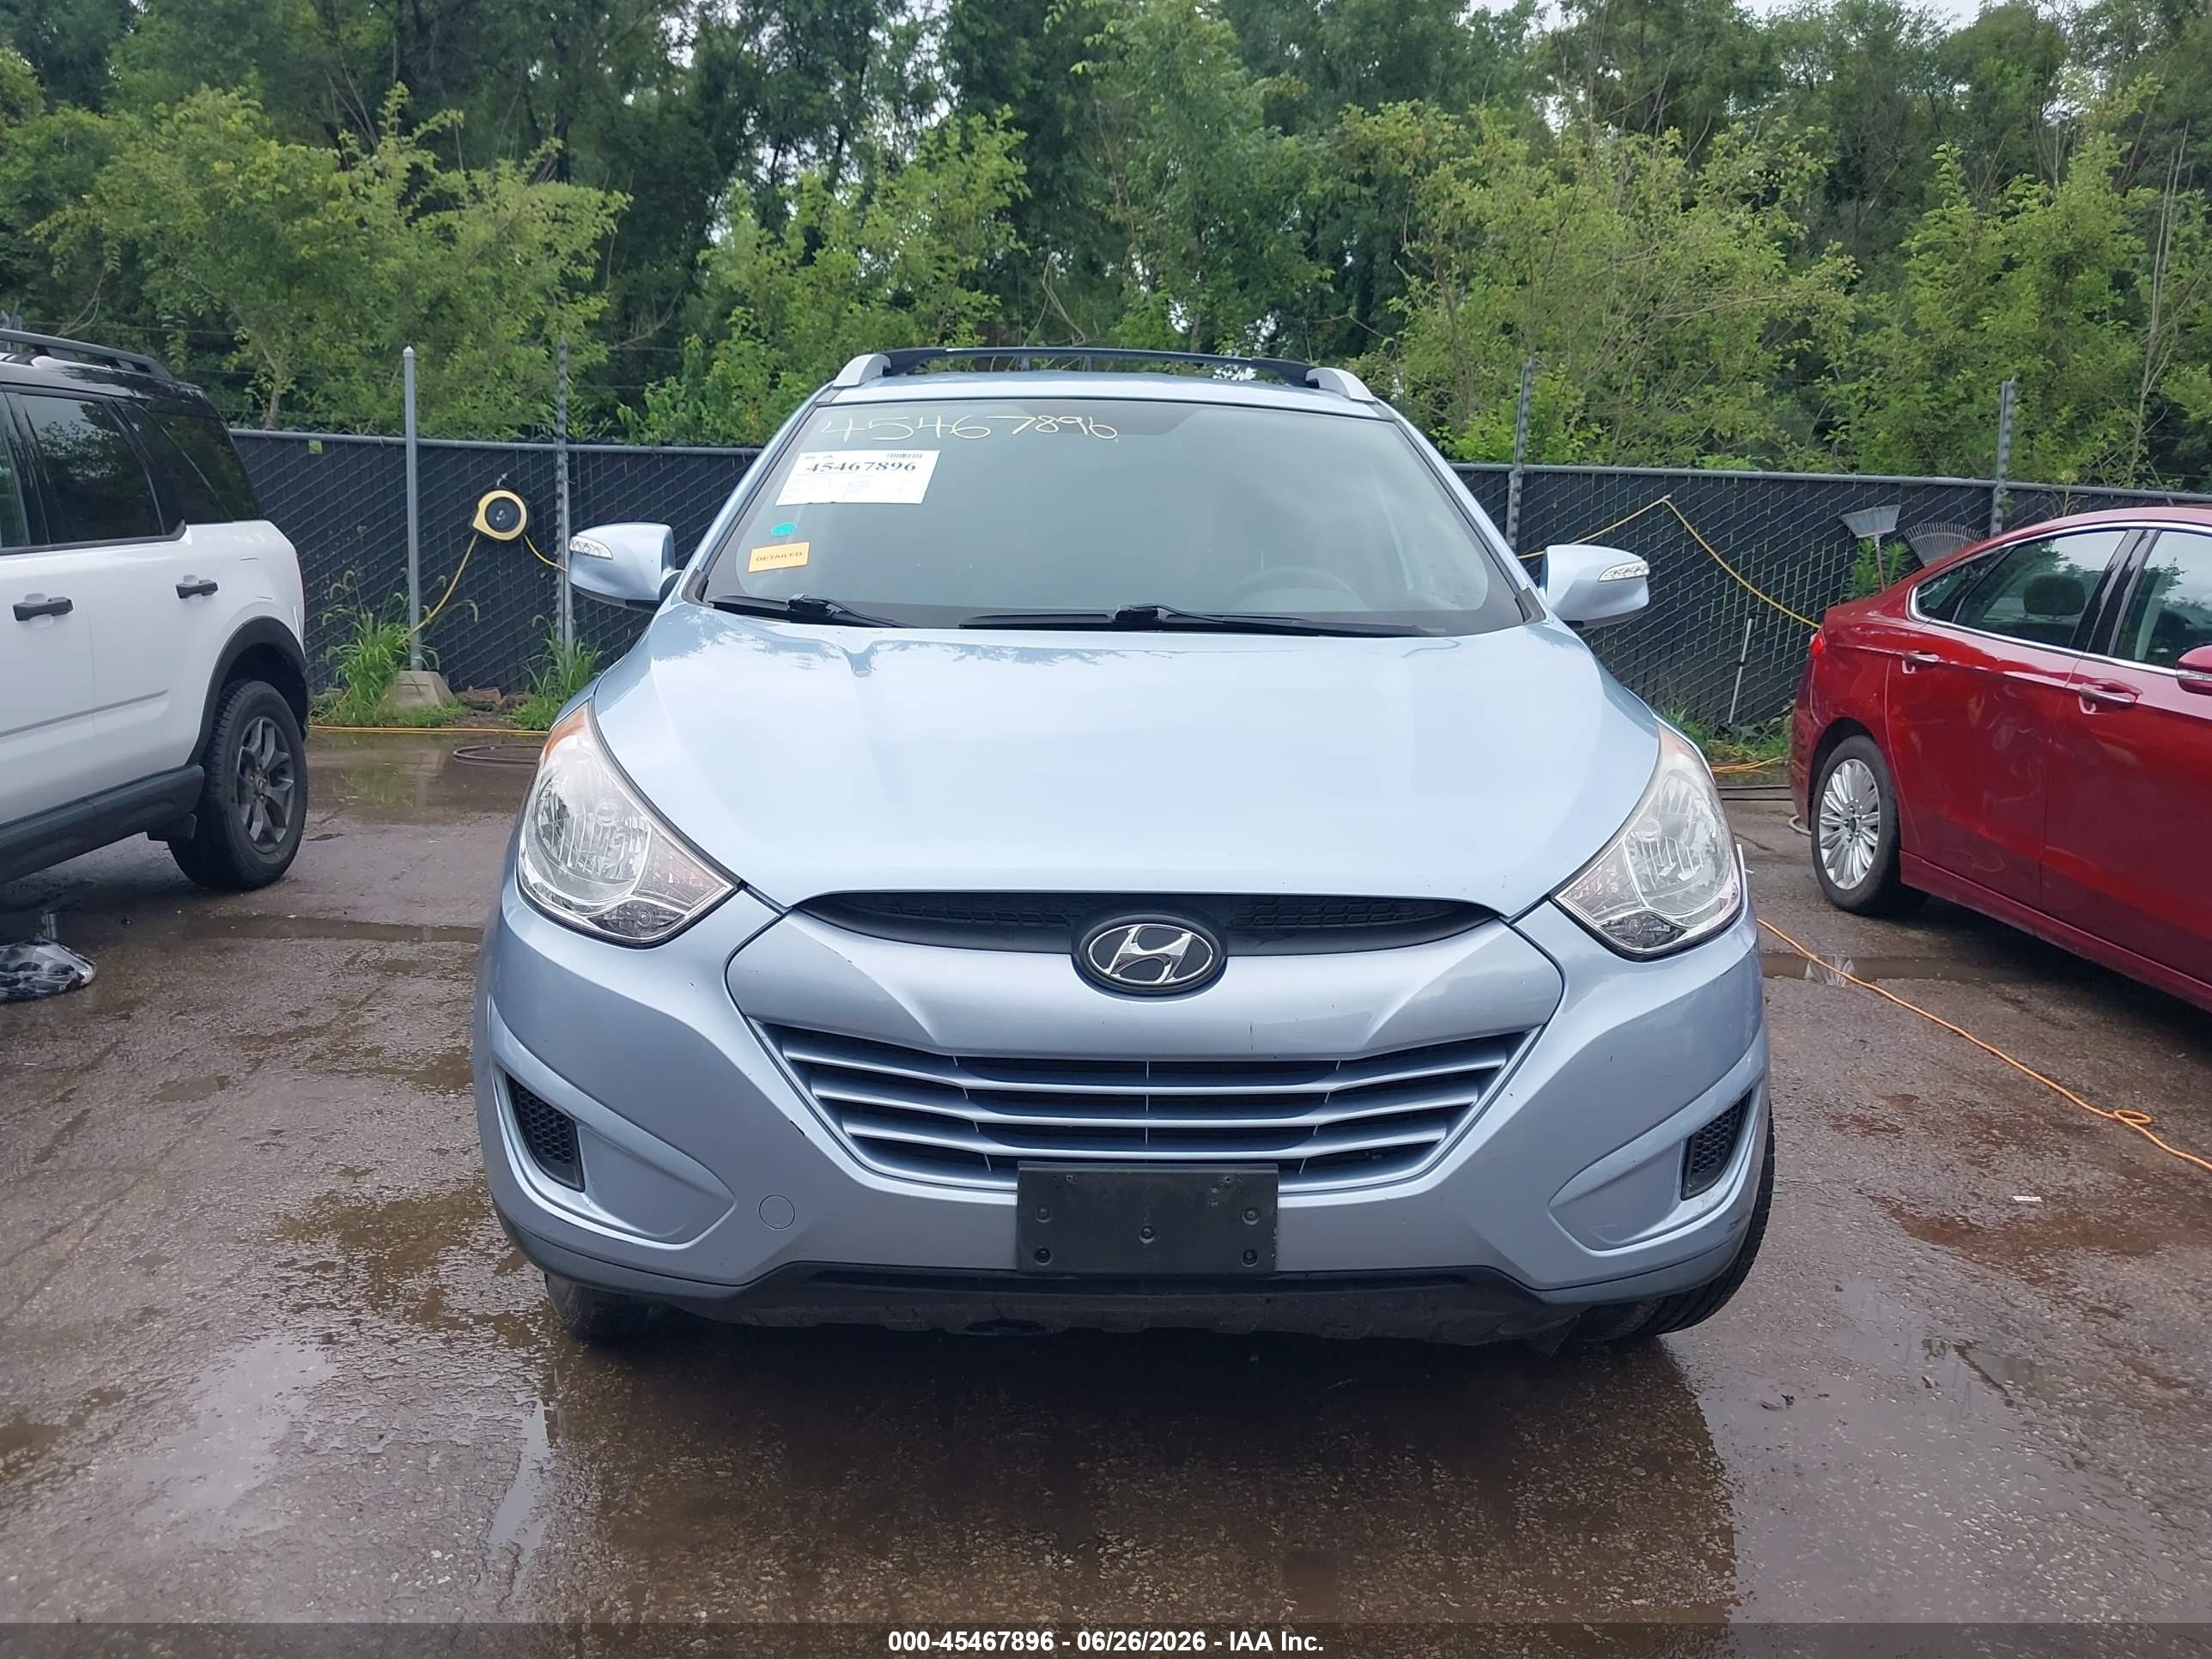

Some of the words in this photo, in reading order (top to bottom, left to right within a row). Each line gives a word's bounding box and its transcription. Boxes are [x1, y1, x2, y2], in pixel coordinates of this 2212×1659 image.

[820, 414, 1118, 442] 45467896
[805, 460, 917, 472] 45467896
[756, 551, 803, 562] DETAILED
